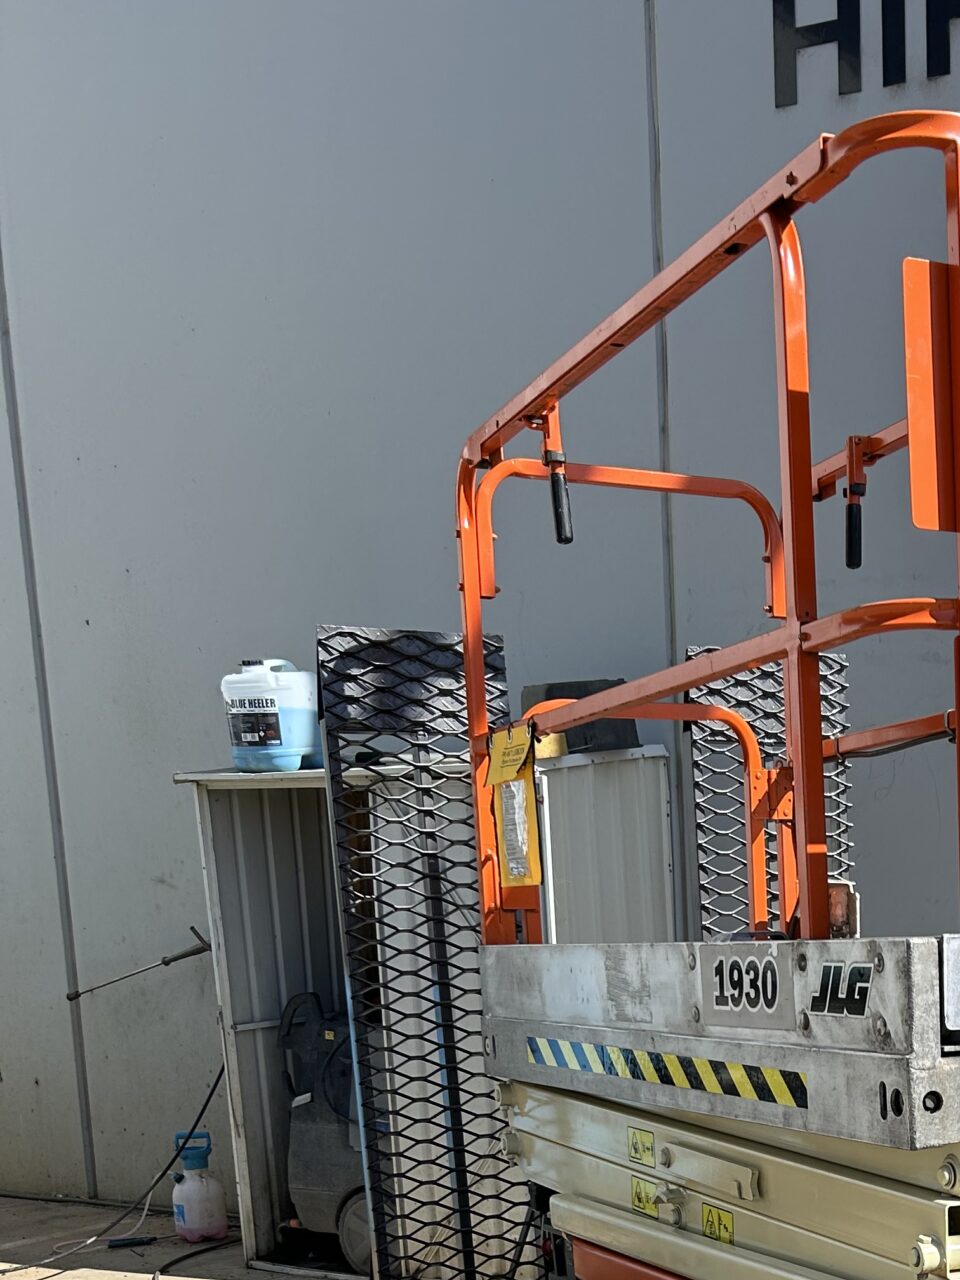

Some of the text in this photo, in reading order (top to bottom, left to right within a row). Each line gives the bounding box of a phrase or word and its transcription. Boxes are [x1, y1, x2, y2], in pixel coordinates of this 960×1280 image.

[230, 698, 276, 709] BLUE HEELER
[713, 957, 779, 1012] 1930
[810, 963, 873, 1017] JLG
